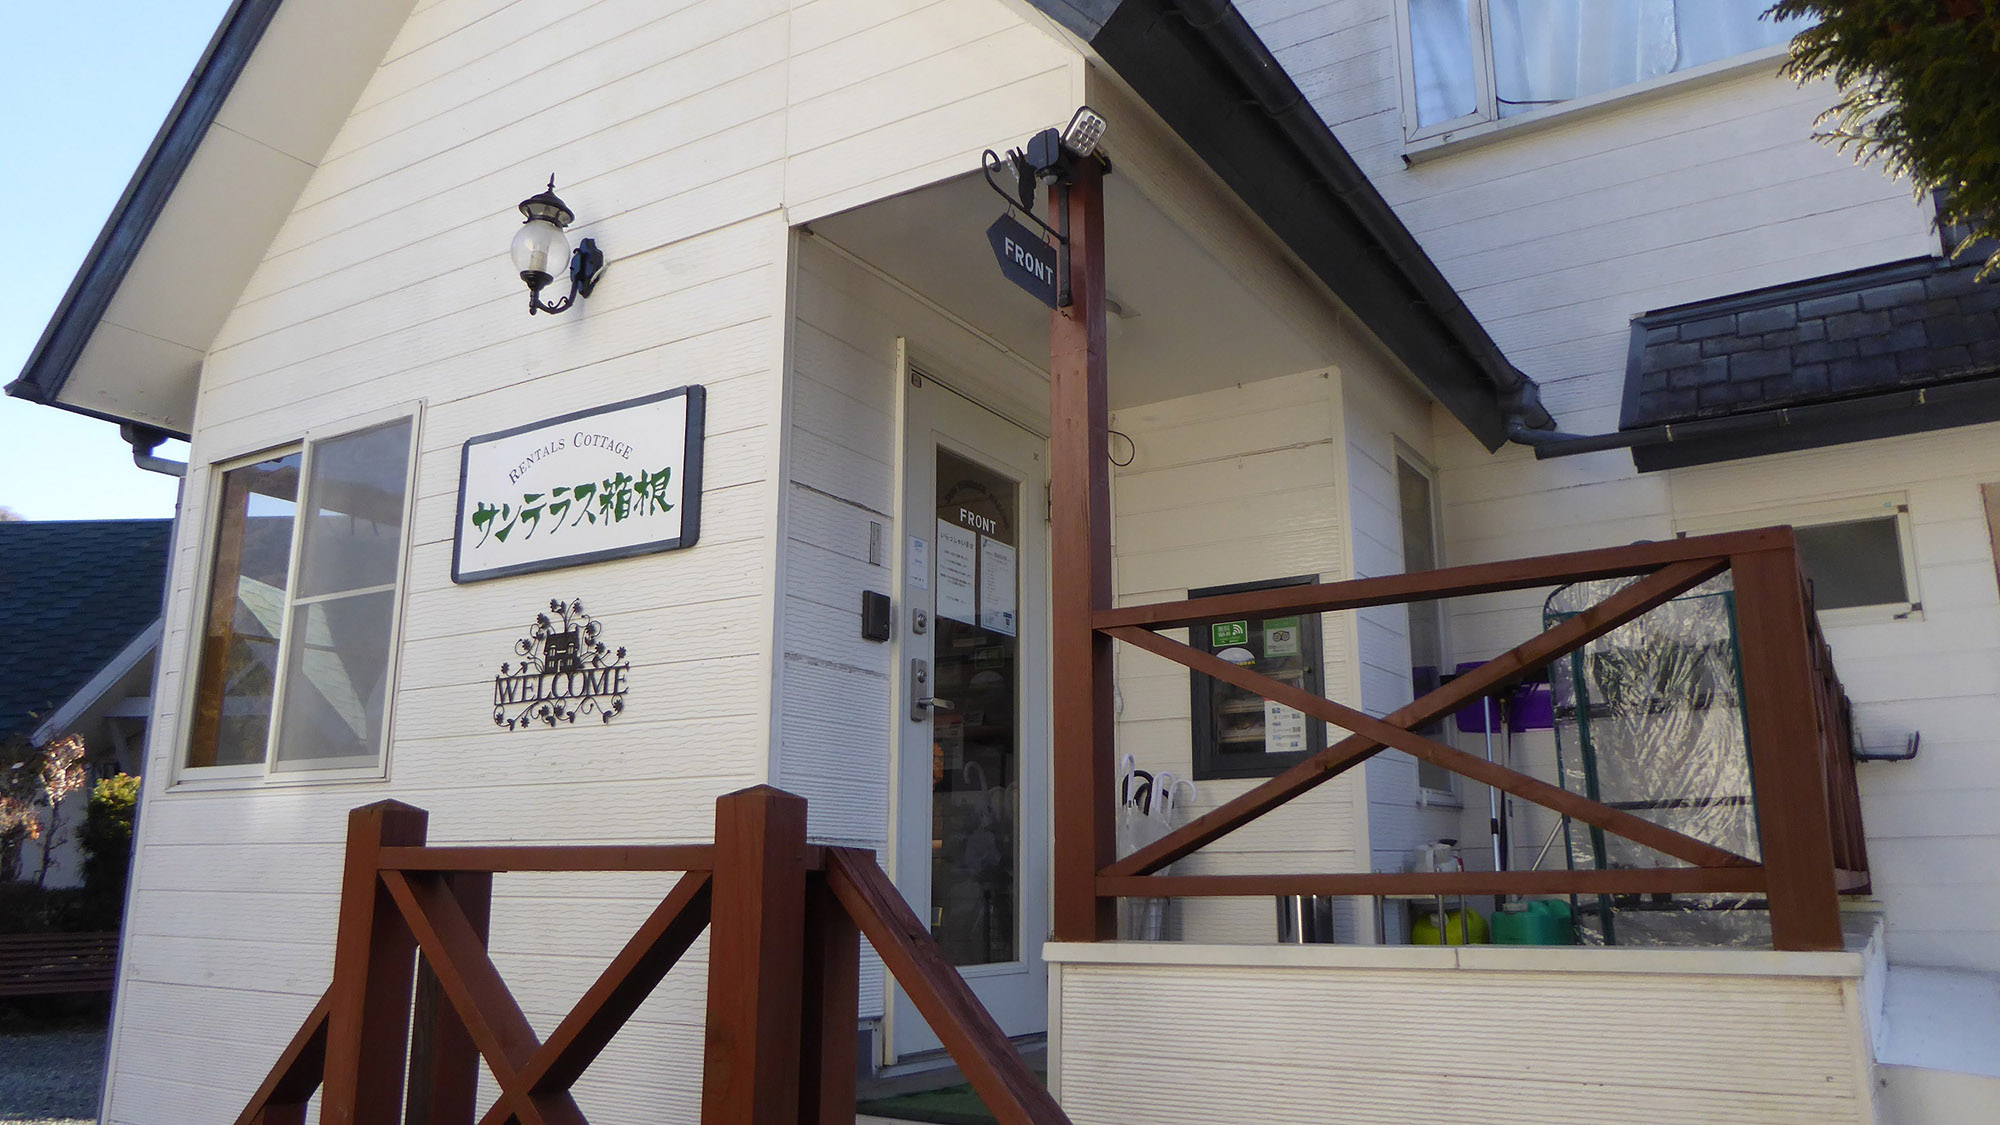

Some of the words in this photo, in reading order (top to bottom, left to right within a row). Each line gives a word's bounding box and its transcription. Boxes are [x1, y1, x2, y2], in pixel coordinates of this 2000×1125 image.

[1004, 236, 1053, 285] FRONT
[508, 438, 565, 485] RENTALS
[573, 431, 633, 460] COTTAGE
[472, 466, 675, 549] サンテラス箱根
[960, 507, 997, 534] FRONT
[494, 667, 629, 706] WELCOME
